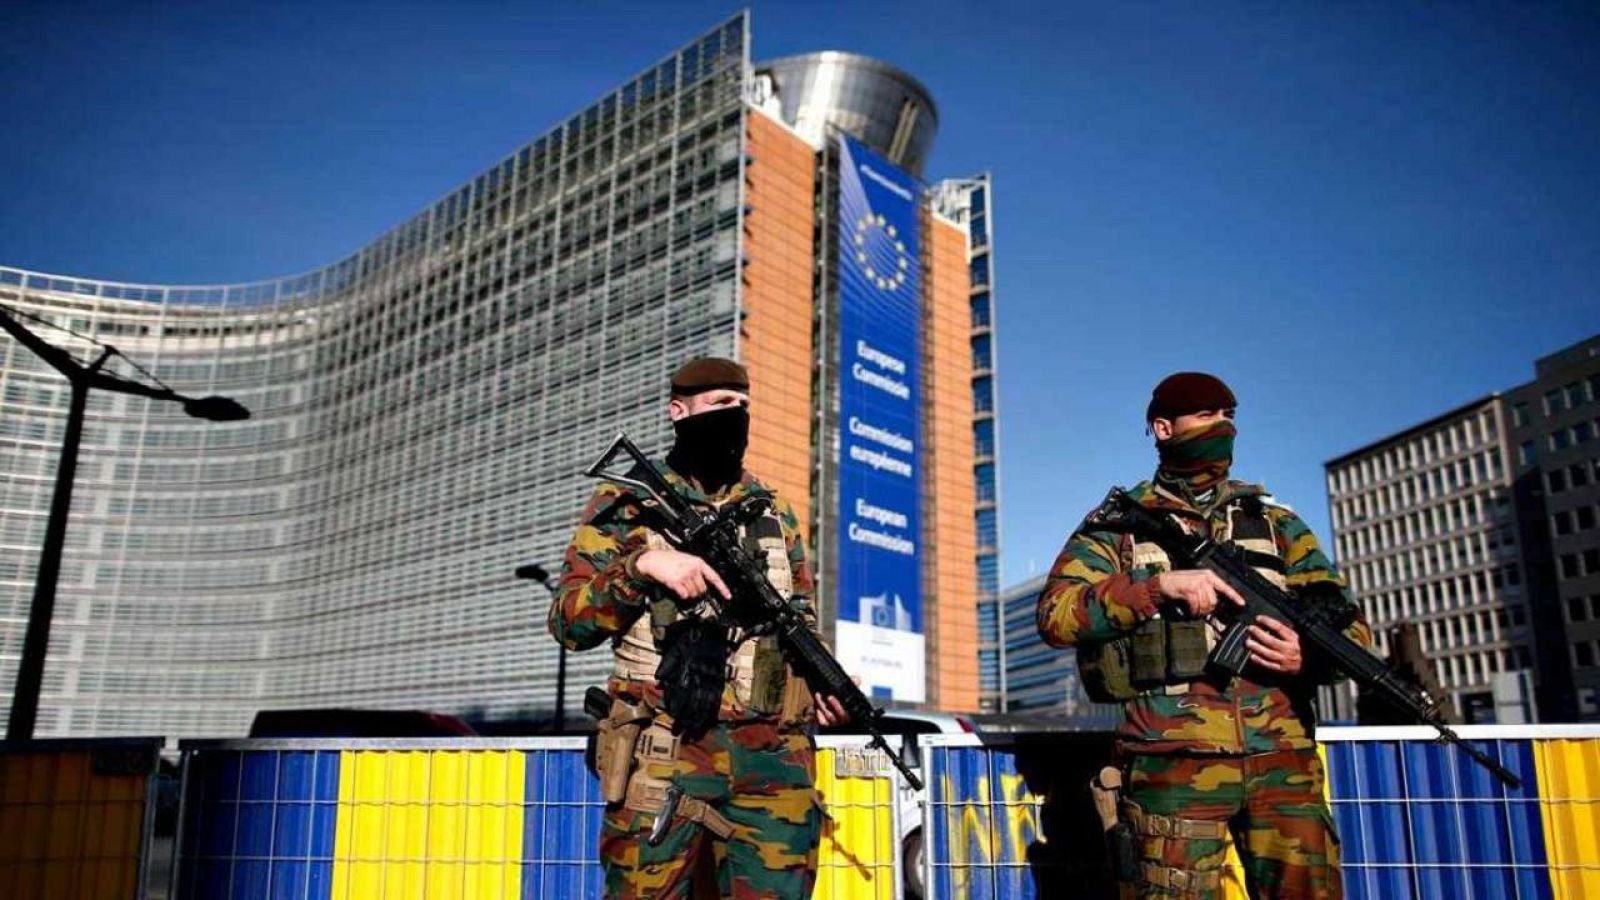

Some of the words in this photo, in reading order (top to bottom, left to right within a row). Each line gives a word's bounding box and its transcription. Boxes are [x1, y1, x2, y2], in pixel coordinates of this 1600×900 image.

[857, 340, 906, 375] Europese
[852, 362, 911, 400] Commissie
[849, 416, 914, 453] Commission
[856, 498, 908, 528] European
[849, 523, 915, 555] Commission
